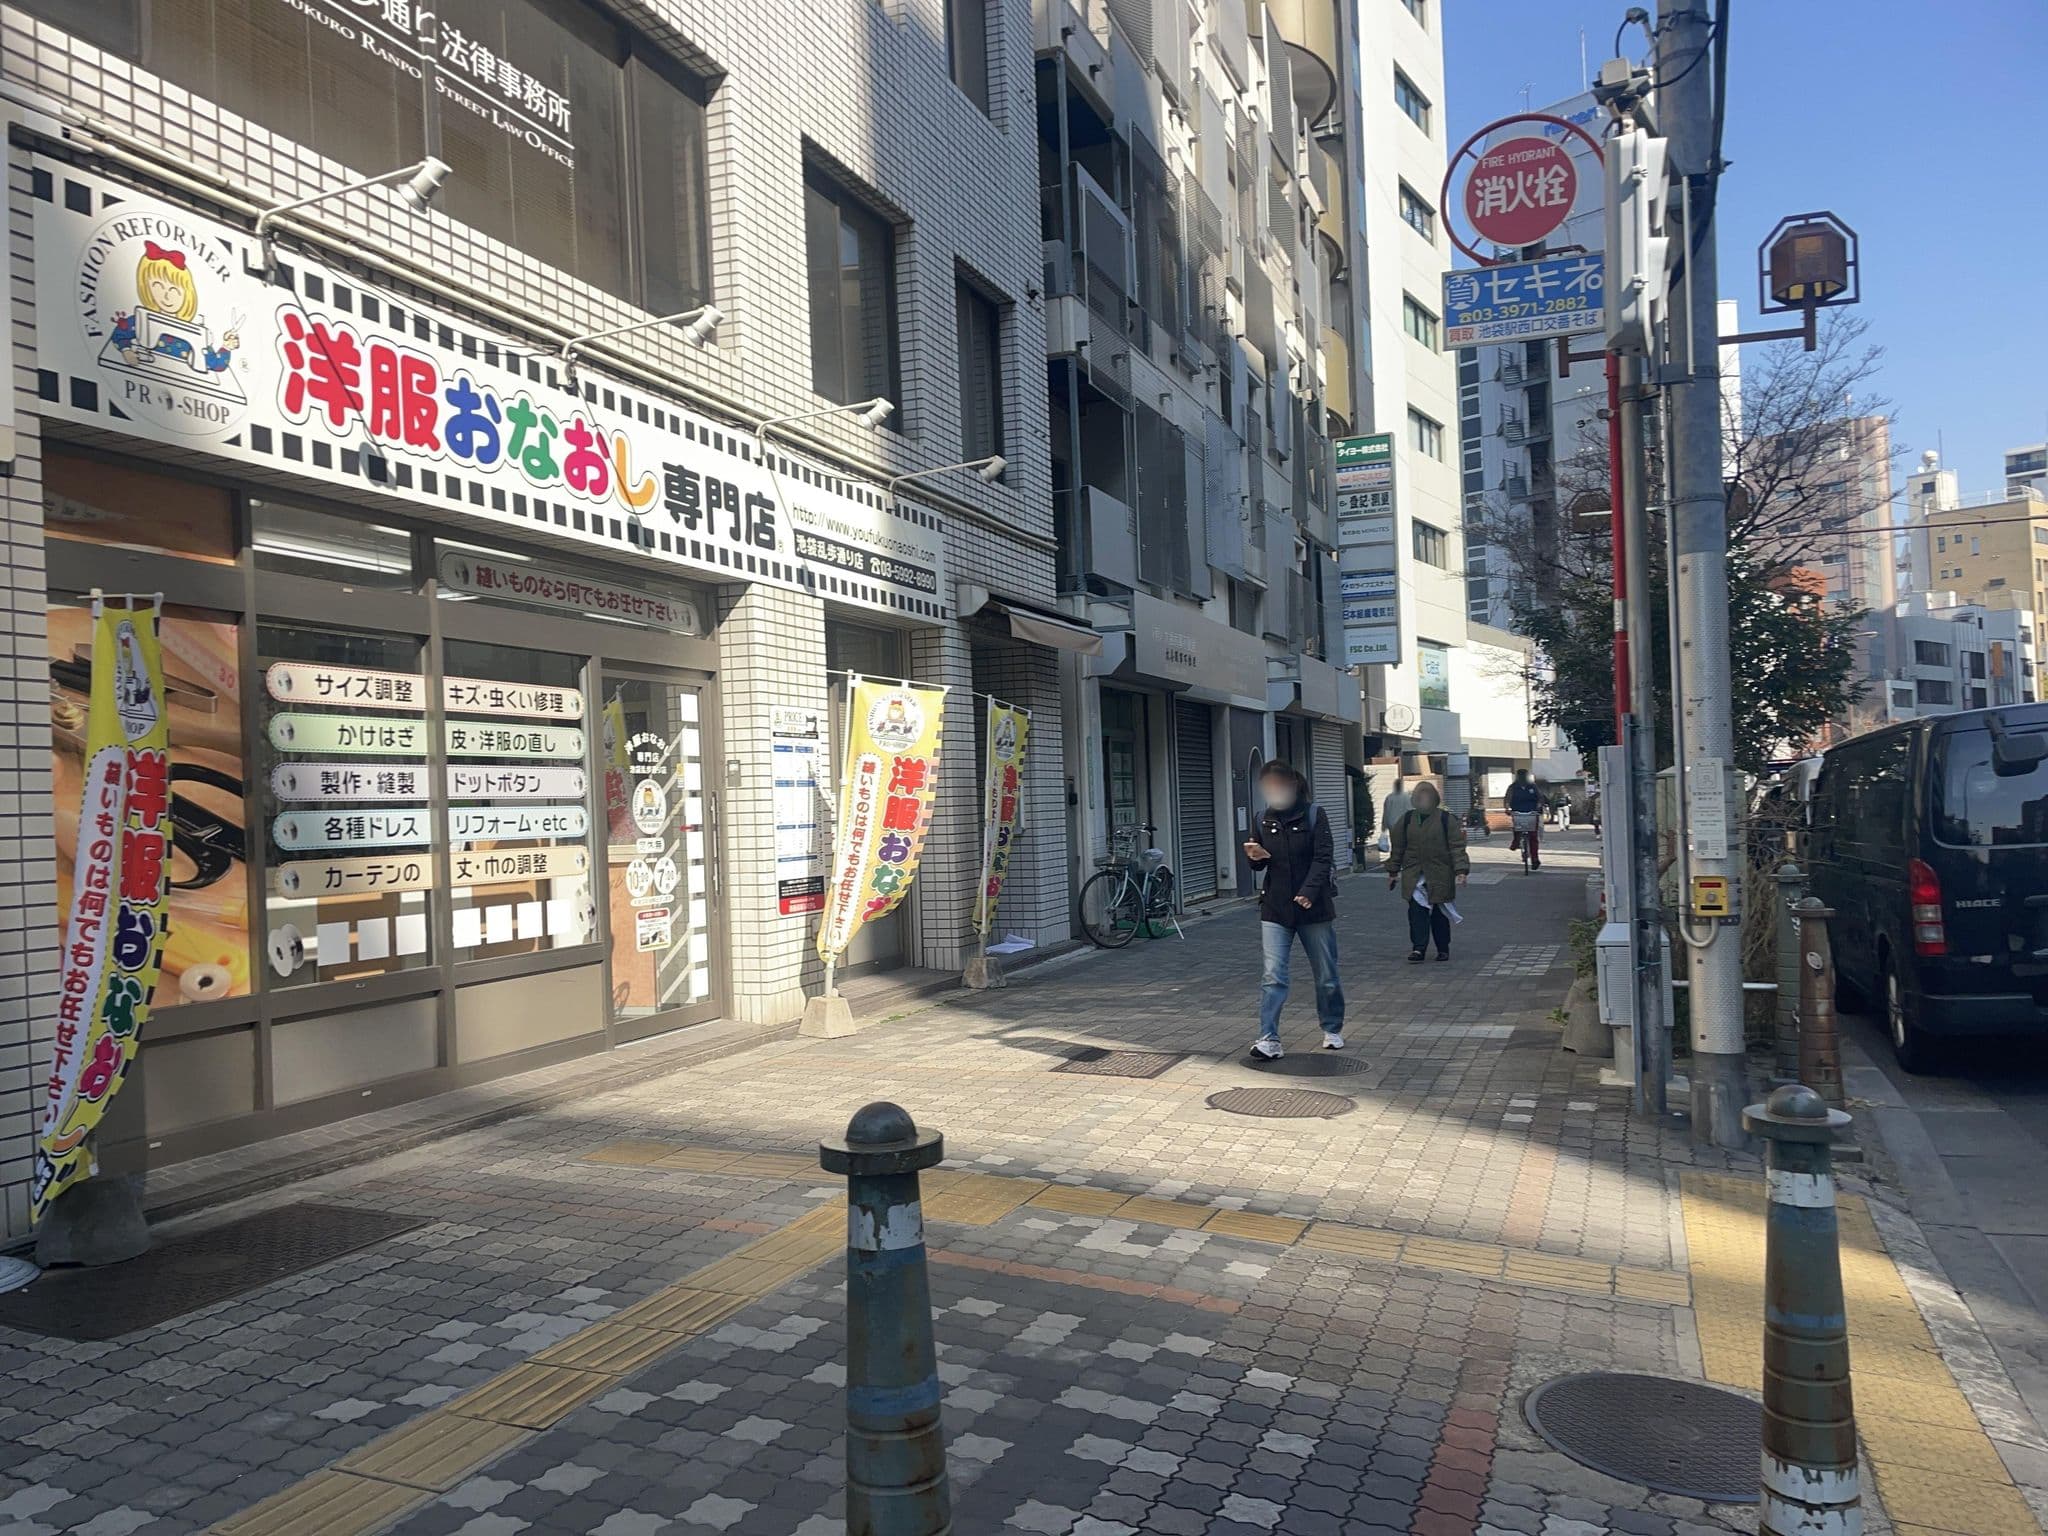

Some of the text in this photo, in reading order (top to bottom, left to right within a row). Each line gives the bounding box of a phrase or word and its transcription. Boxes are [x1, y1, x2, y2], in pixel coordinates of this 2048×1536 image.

[352, 0, 571, 133] 通り法律事務所
[279, 0, 575, 169] UKURO RANPO STREET LAW OFFICE
[1482, 146, 1557, 169] FIRE HYDRANT
[1475, 164, 1569, 218] 消火栓
[80, 216, 232, 338] FASHION REFORMER
[1472, 295, 1588, 322] 03-3971-2882
[475, 564, 678, 622] 縫いものなら何でもお任せ下さい
[315, 674, 413, 702] サイズ調整
[448, 684, 564, 713] キズ・虫くい修理
[338, 724, 415, 748] かけはぎ
[451, 728, 556, 753] 皮・洋服の直し
[320, 771, 415, 795] 製作・縫製
[454, 772, 542, 793] ドットボタン
[324, 816, 419, 841] 各種ドレス
[455, 813, 568, 835] リフォーム・etc
[325, 854, 548, 889] カーテンの 丈・巾の調整
[1955, 898, 2001, 909] HIACE
